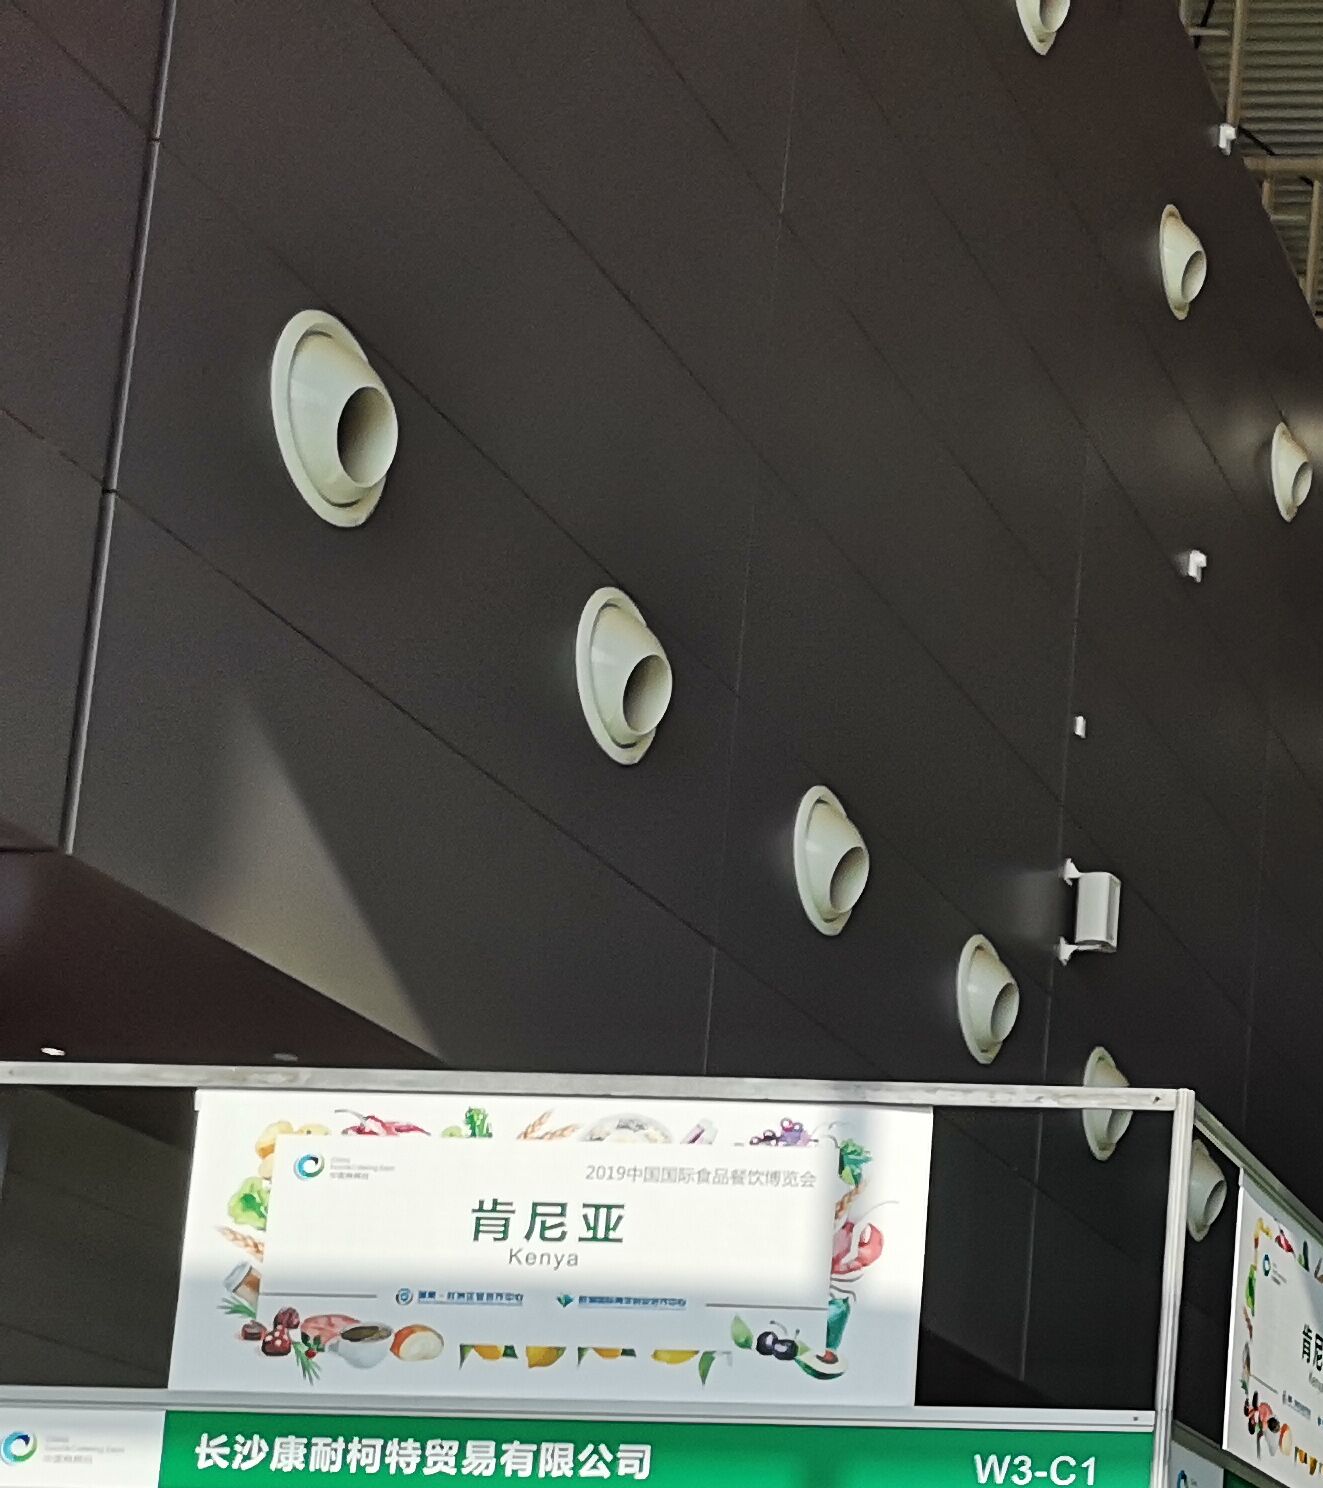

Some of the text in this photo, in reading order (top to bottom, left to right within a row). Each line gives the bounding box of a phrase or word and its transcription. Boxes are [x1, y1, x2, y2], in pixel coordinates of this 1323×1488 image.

[585, 1165, 817, 1188] 2019中国国际食品餐饮博览会
[471, 1198, 625, 1243] 肯尼亚
[508, 1248, 579, 1270] Kenya
[195, 1433, 652, 1479] 长沙康耐柯特贸易有限公司
[973, 1454, 1096, 1486] W3-C1
